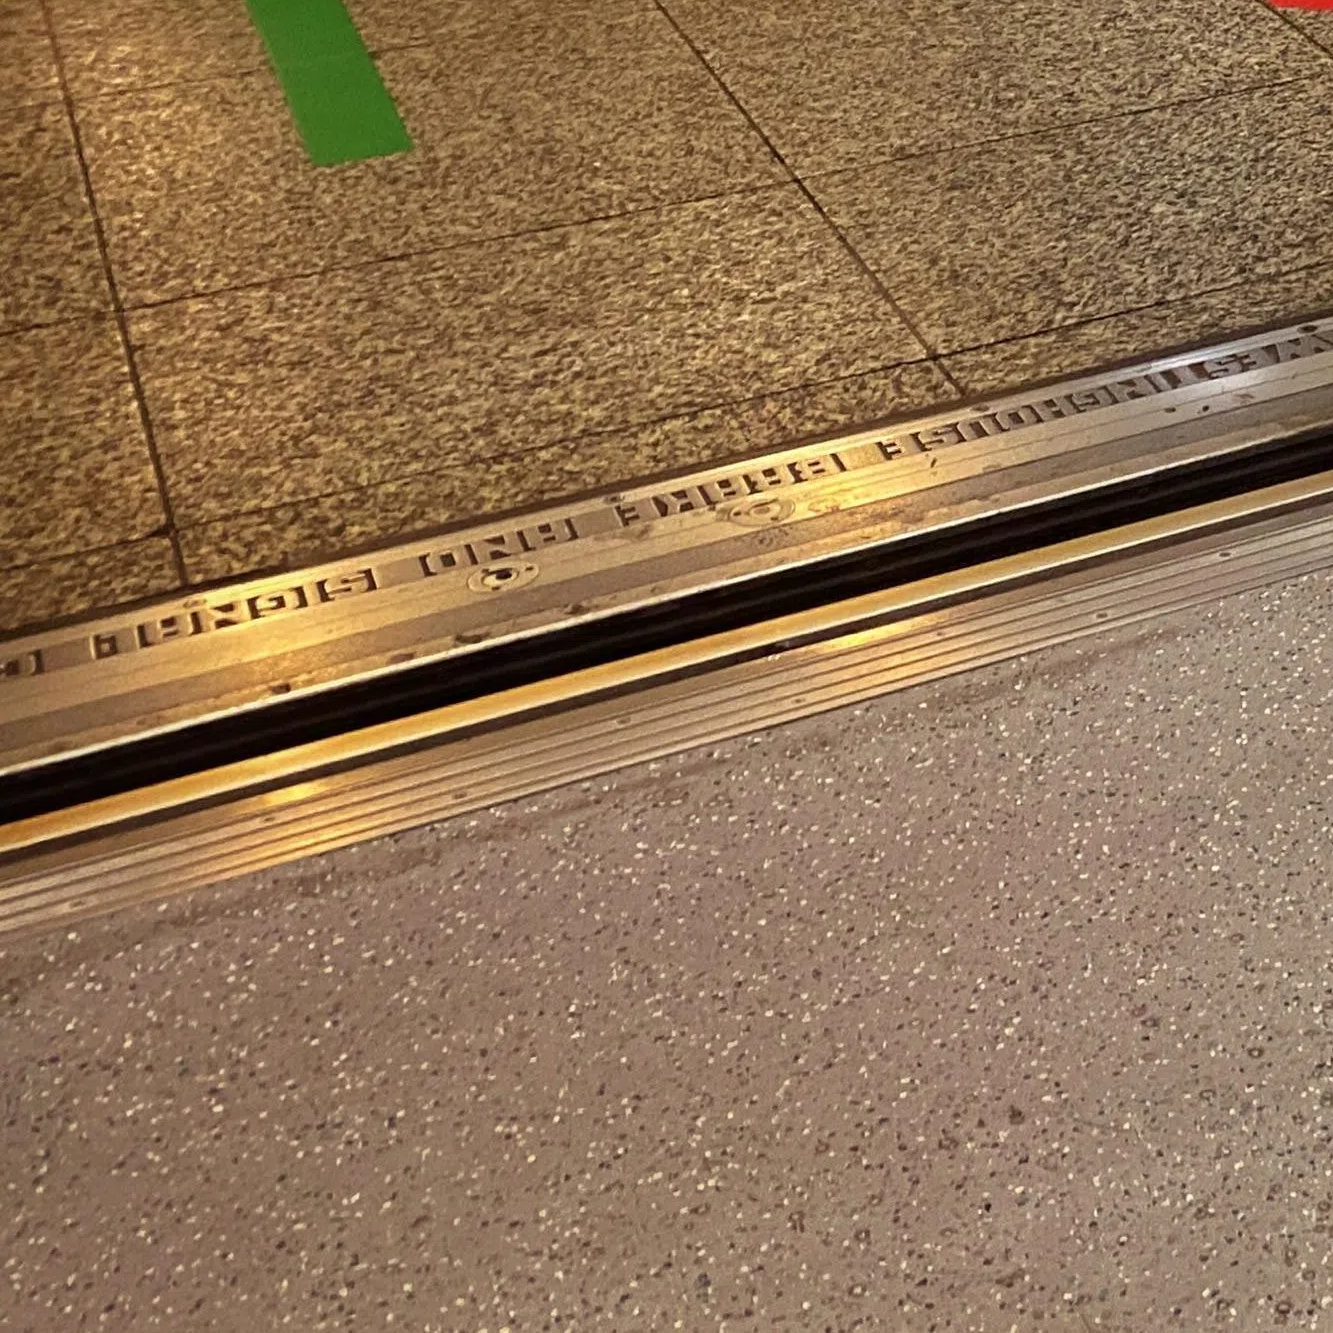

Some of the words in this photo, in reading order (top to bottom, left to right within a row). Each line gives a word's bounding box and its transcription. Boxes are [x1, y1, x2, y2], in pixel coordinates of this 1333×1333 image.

[617, 452, 846, 527] BRAKE
[418, 517, 580, 577] AND
[92, 567, 377, 659] SIGNAL
